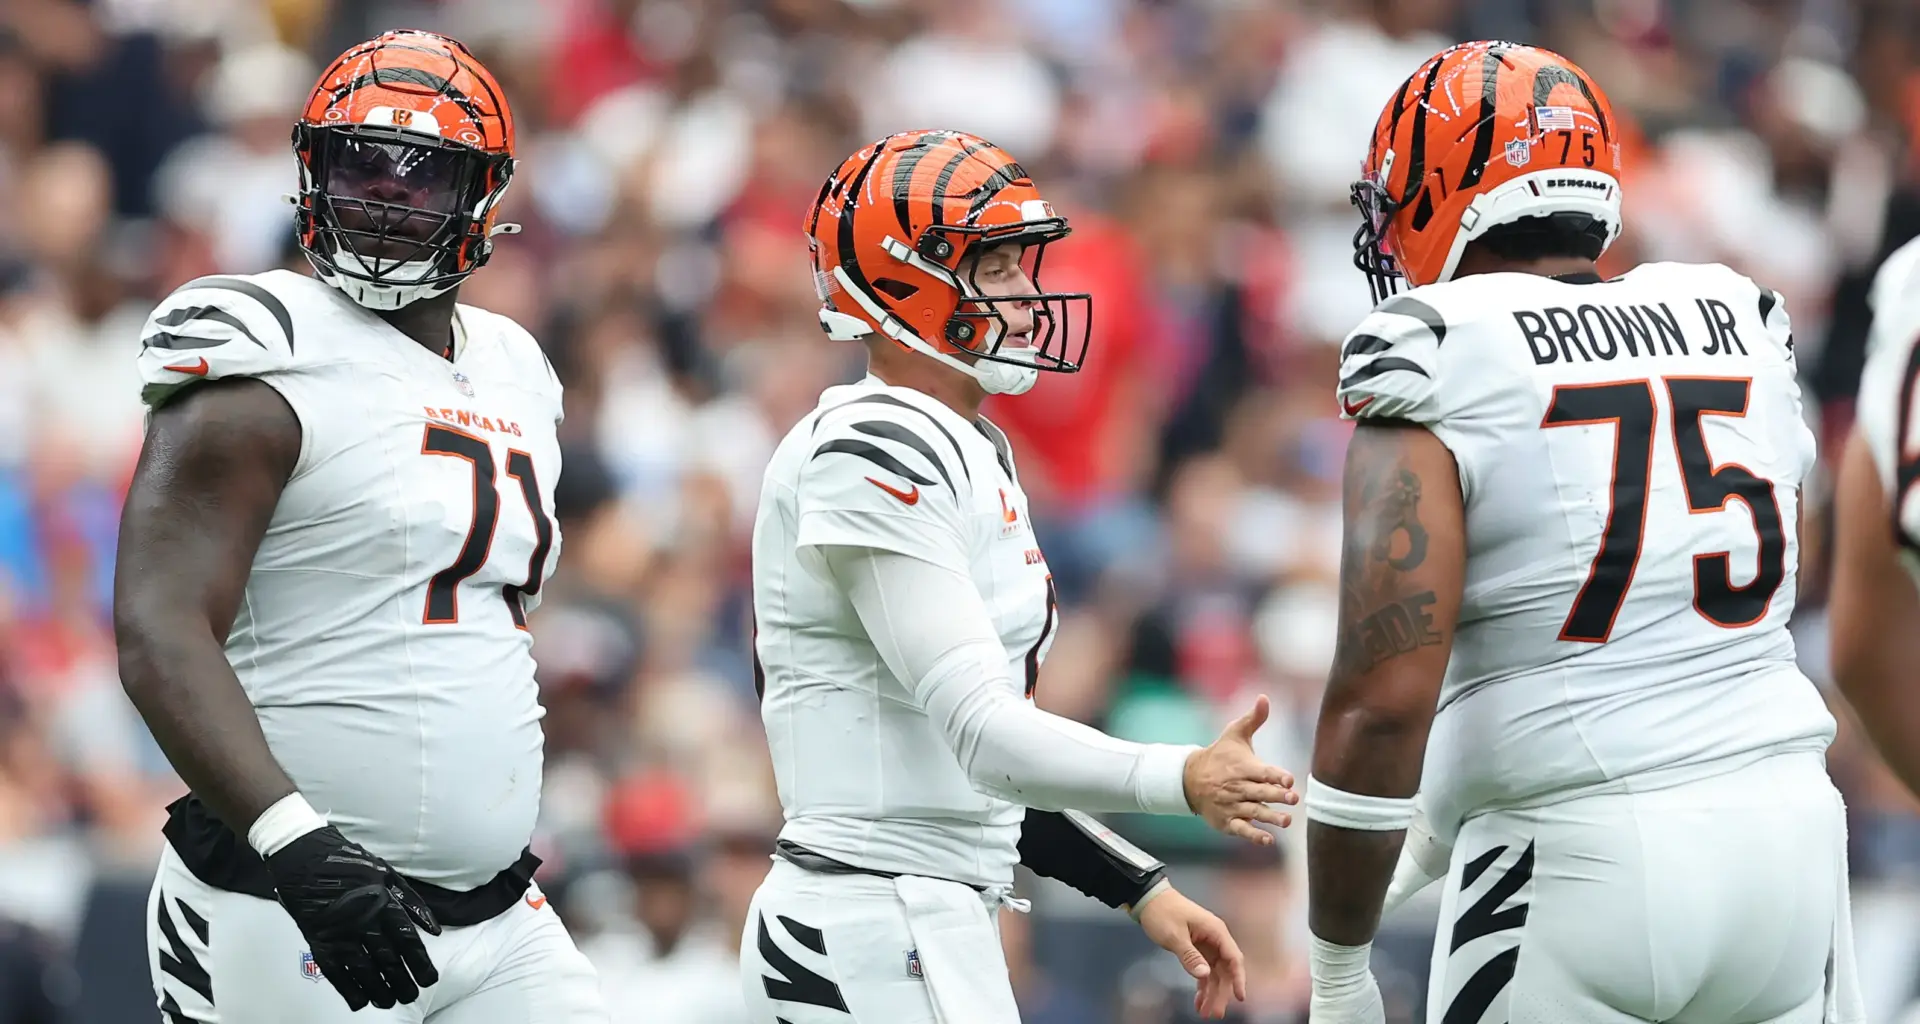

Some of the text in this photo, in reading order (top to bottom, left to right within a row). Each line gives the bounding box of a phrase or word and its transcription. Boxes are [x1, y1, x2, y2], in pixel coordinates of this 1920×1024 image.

[1509, 150, 1527, 161] NFL
[1547, 179, 1607, 191] BENGALS
[1512, 298, 1749, 365] BROWN JR
[423, 406, 523, 438] BENGALS
[420, 422, 553, 631] 71
[1540, 375, 1786, 645] 75
